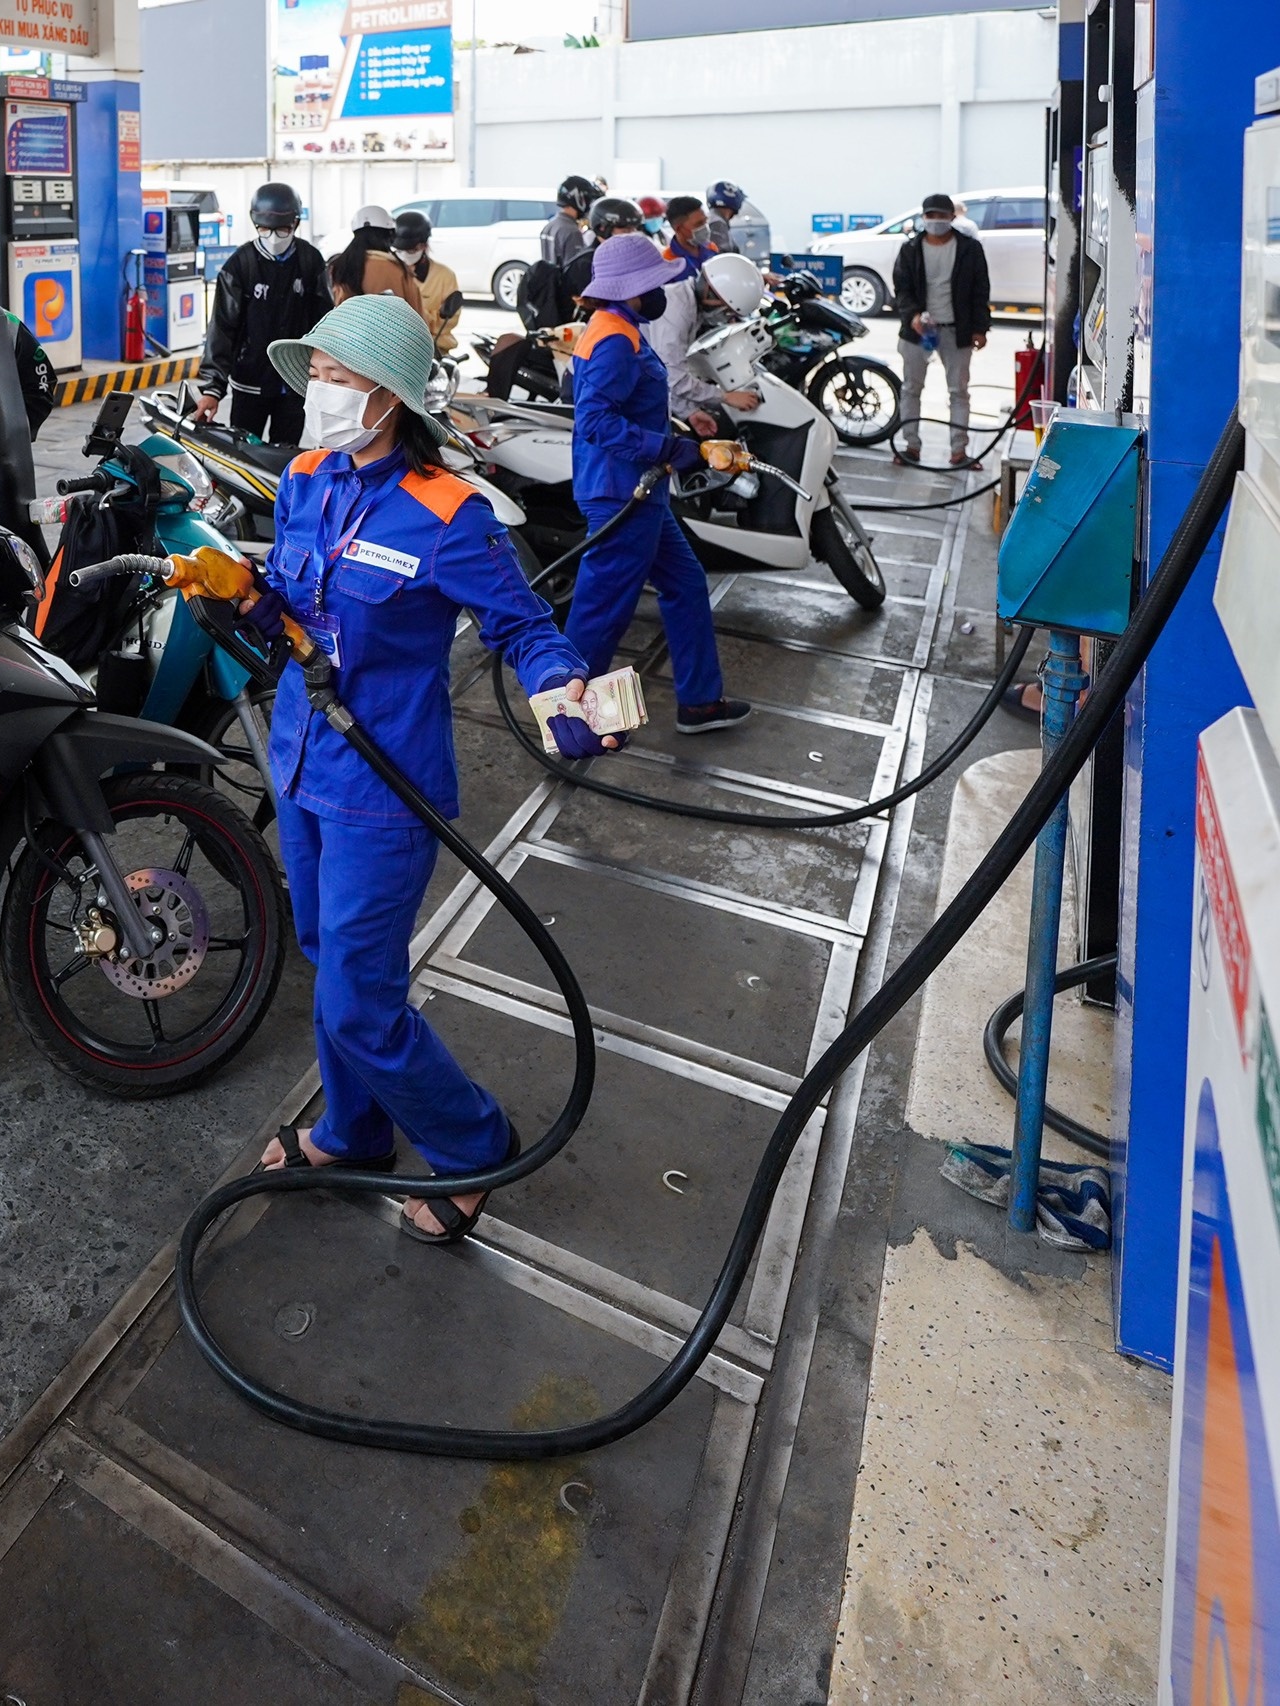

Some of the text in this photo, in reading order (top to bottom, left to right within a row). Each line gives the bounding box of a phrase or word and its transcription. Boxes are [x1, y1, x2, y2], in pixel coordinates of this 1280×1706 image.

[351, 1, 448, 29] PETROLIMEX
[17, 21, 39, 39] MUA
[360, 548, 415, 571] PETROLIMEX
